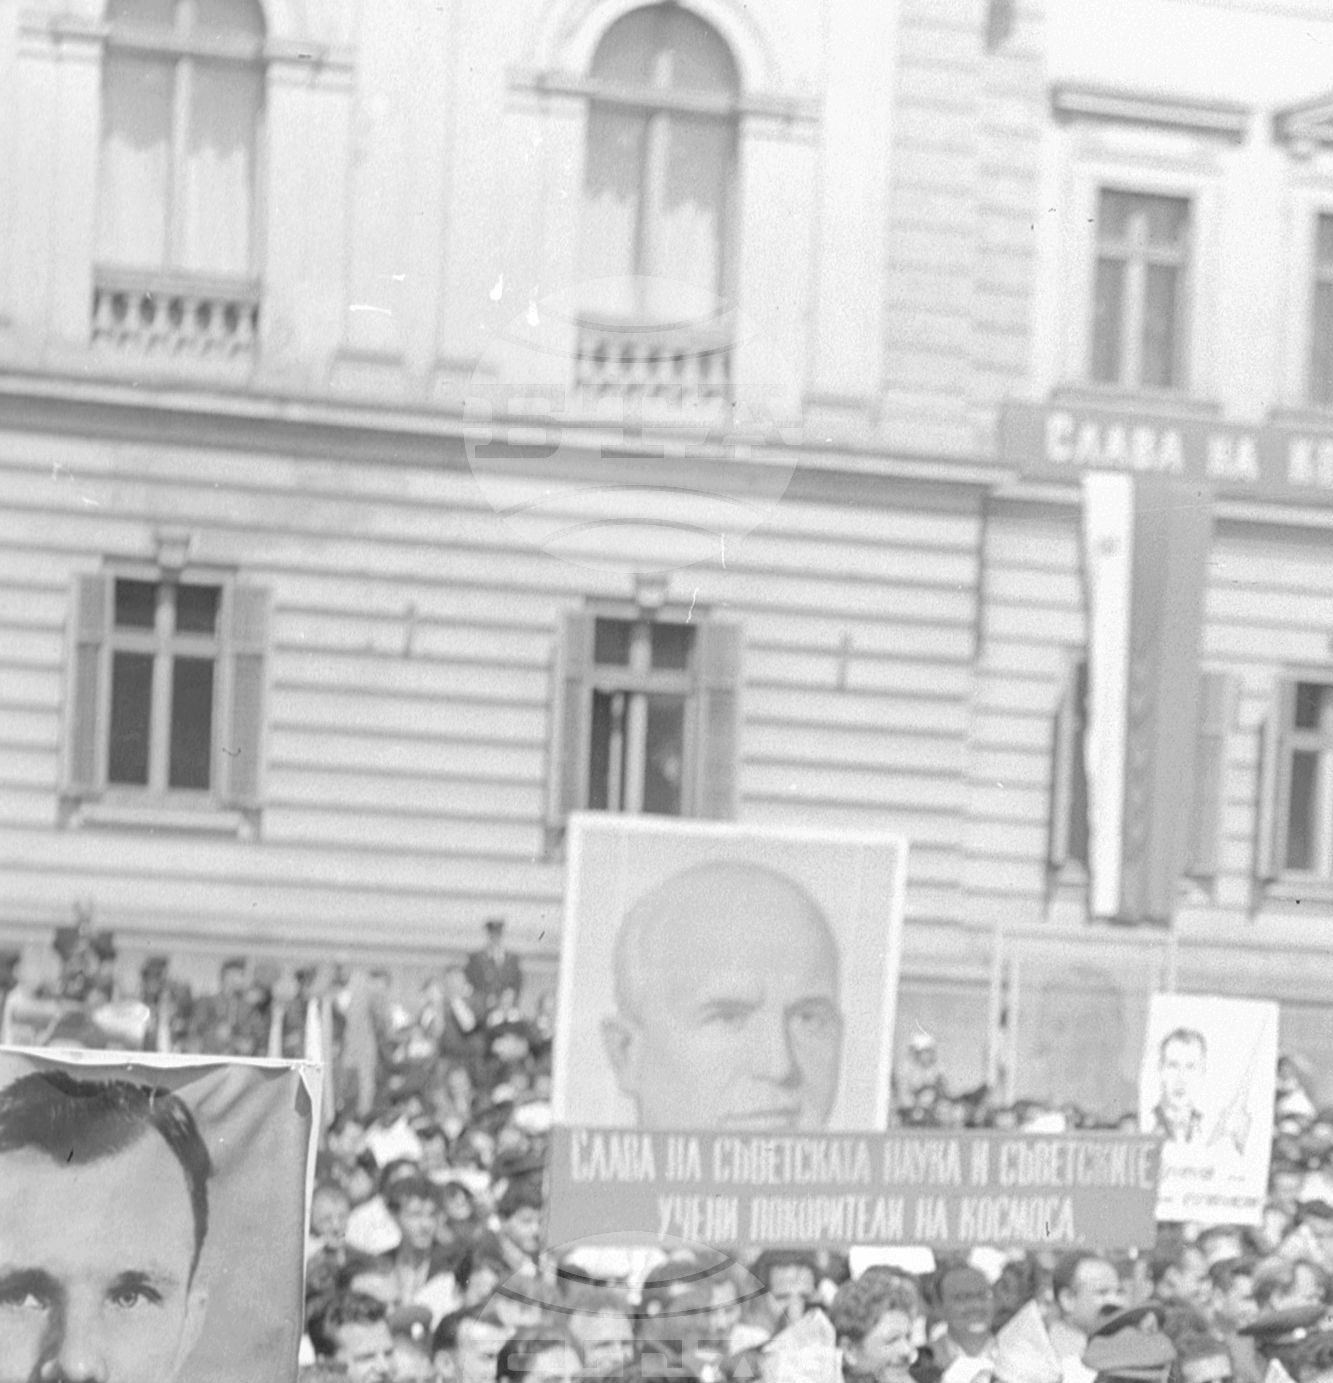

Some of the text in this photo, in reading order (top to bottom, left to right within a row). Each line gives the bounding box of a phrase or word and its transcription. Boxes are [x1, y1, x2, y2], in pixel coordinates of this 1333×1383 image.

[1041, 411, 1185, 474] СЛАВА
[1206, 436, 1260, 482] НА
[569, 1129, 1158, 1189] СЛАВА НА СЪВЕТСКАТА НАУКА И СЪВЕТСКИТЕ
[657, 1195, 739, 1242] УЧЕНИ
[749, 1194, 904, 1242] ПОКОРИТЕЛИ
[913, 1194, 949, 1241] НА
